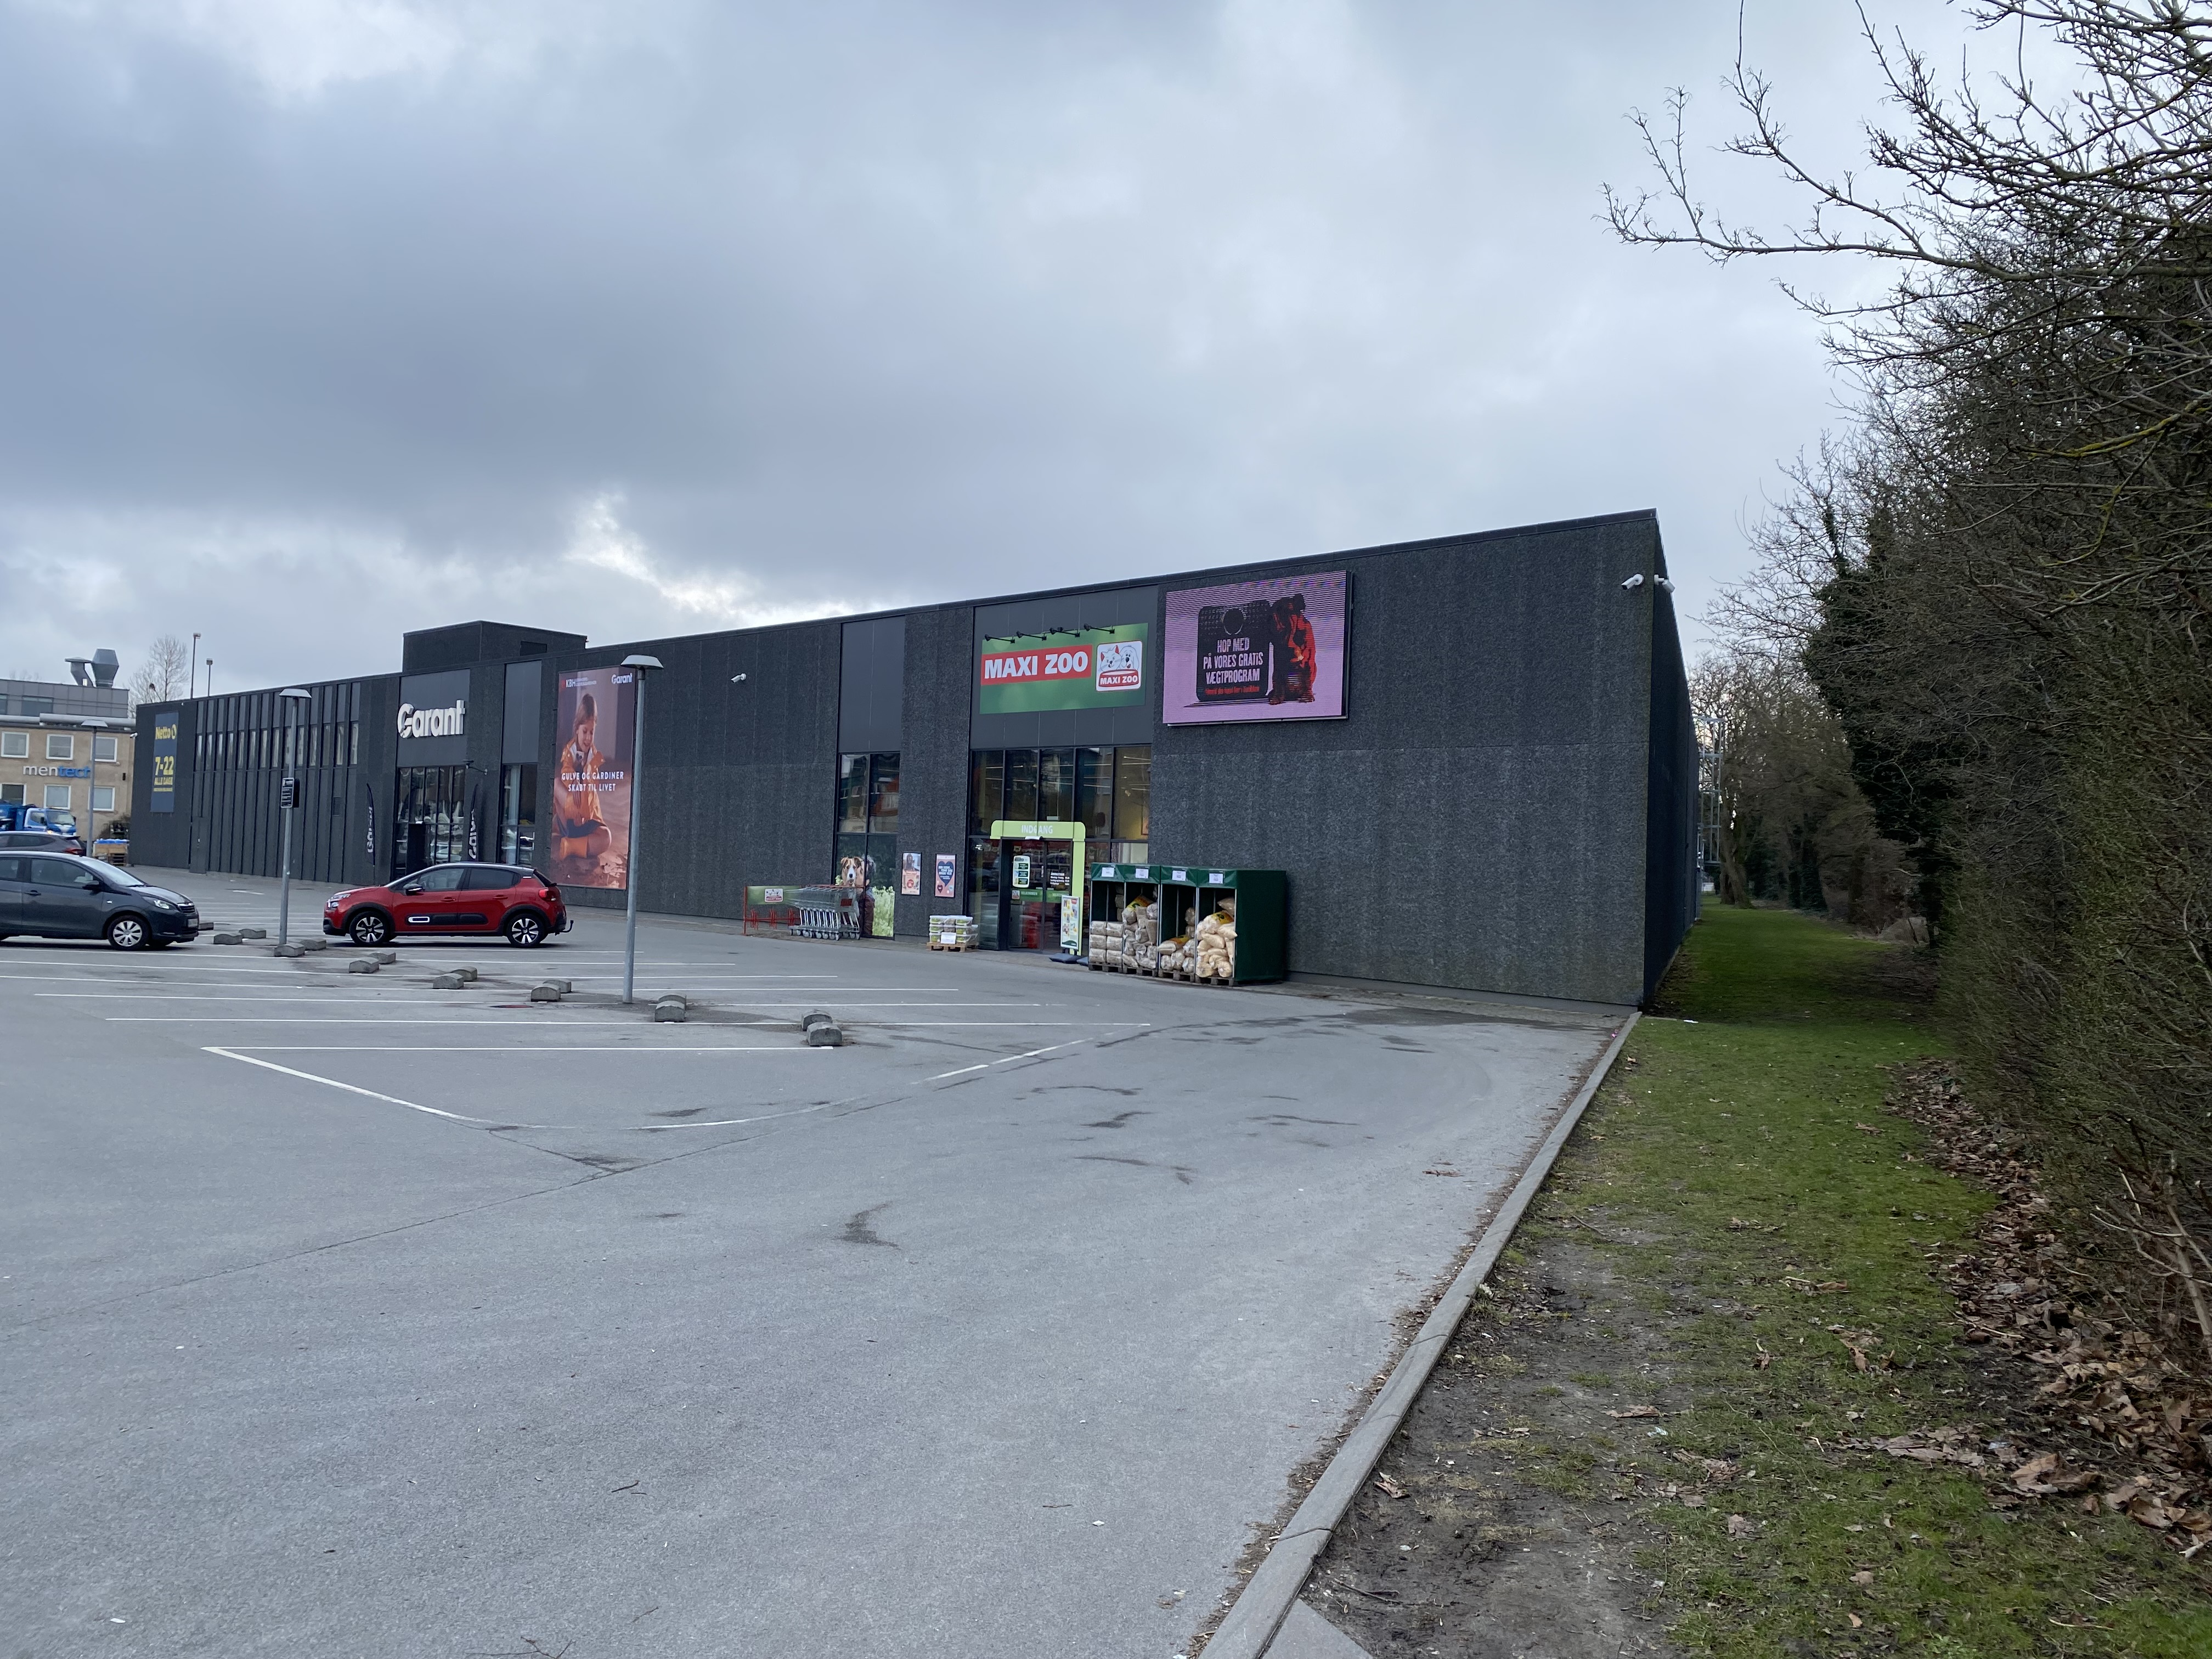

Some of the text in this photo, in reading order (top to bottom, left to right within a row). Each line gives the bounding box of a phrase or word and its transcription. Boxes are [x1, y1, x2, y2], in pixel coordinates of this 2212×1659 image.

[1217, 637, 1250, 653] HOP MED
[984, 651, 1088, 679] MAXI ZOO
[1203, 652, 1212, 669] PÅ
[1214, 654, 1237, 669] VORES
[611, 673, 633, 684] Garant
[1100, 675, 1138, 685] MAXI ZOO
[1206, 668, 1260, 684] VÆGTPROGRAM
[566, 679, 576, 688] KBH
[397, 699, 466, 738] Garant
[155, 726, 171, 740] Netto
[155, 755, 174, 776] 7-22
[561, 771, 624, 781] GULVE OG GARDINER
[568, 783, 586, 792] SKABT
[599, 783, 616, 791] LIVET
[1021, 825, 1053, 834] INDGANG
